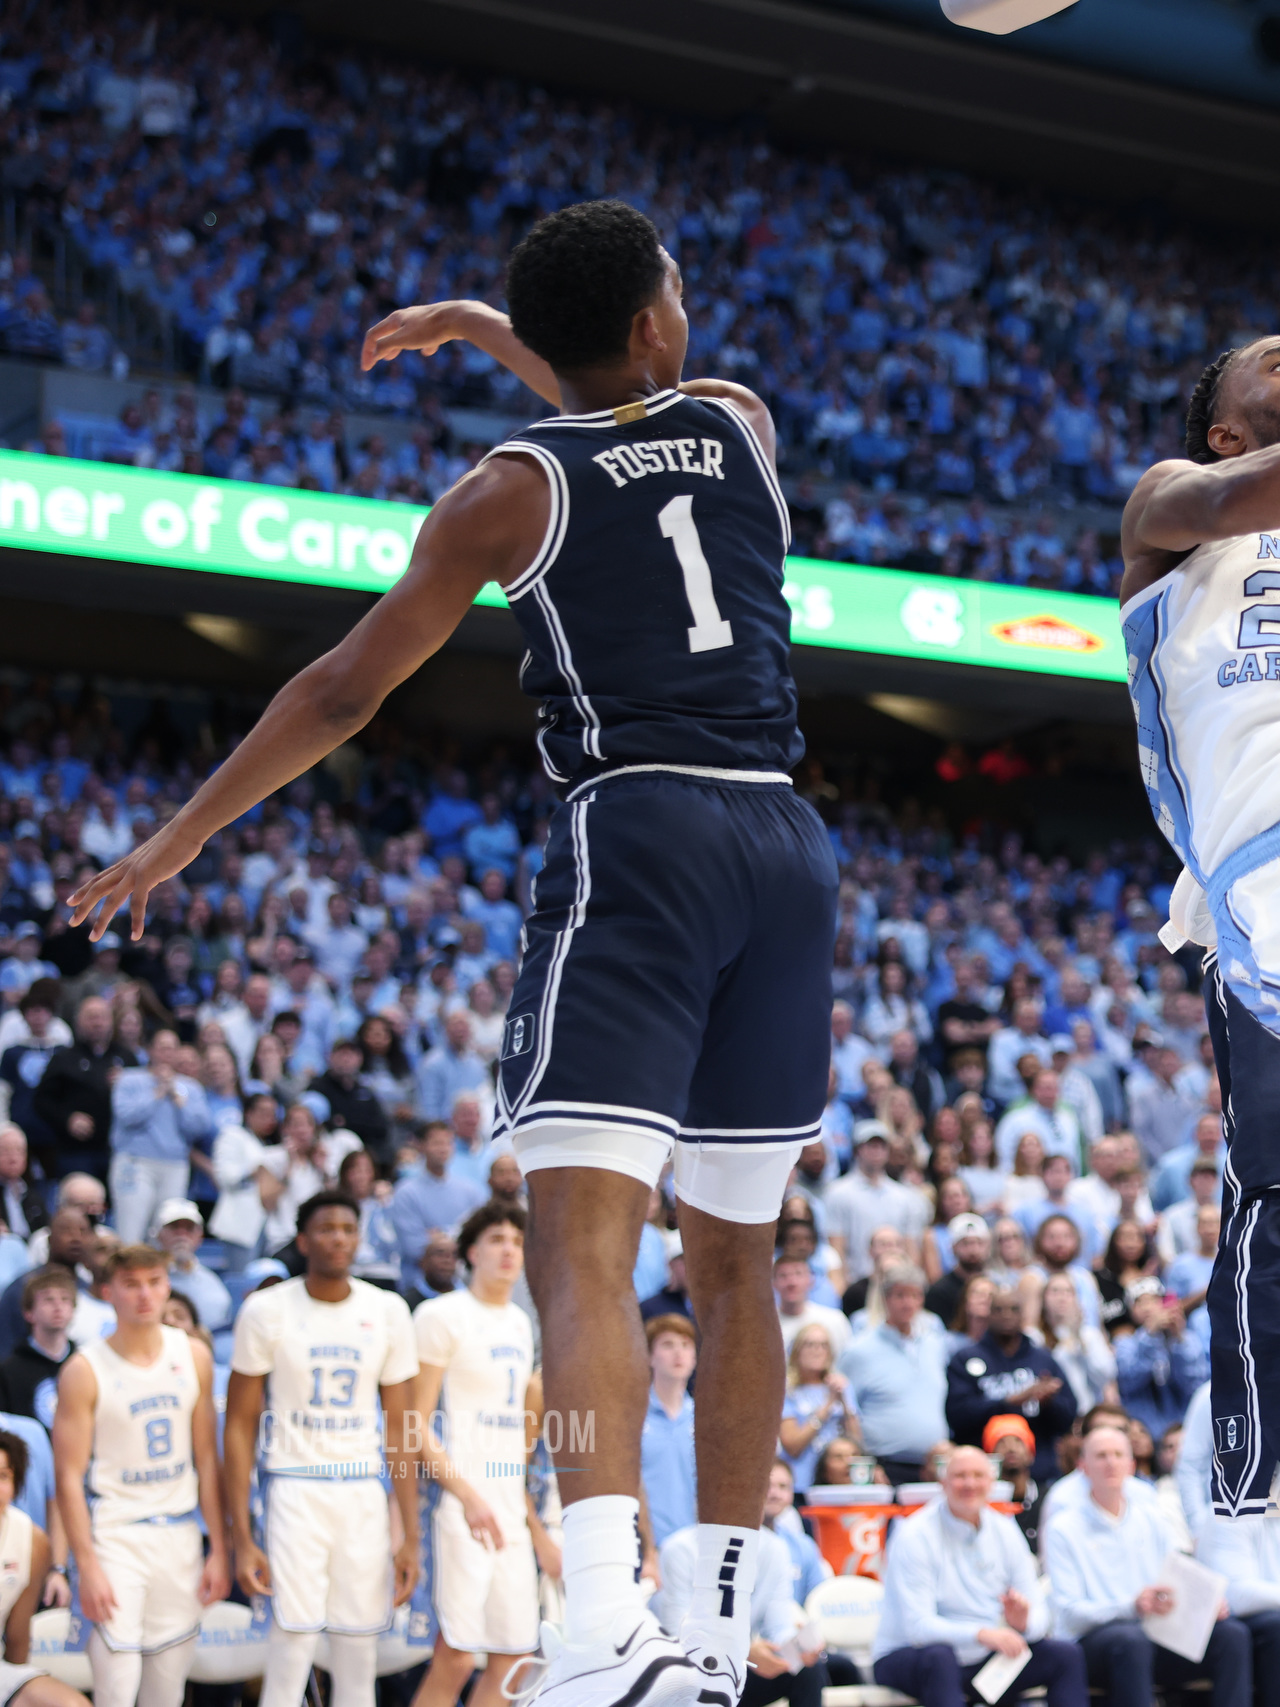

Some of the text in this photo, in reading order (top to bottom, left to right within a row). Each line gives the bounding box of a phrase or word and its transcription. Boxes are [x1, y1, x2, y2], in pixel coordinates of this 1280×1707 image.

[591, 438, 725, 488] FOSTER
[142, 485, 223, 554] of
[658, 494, 734, 654] 1
[309, 1366, 357, 1407] 13
[145, 1417, 171, 1458] 8
